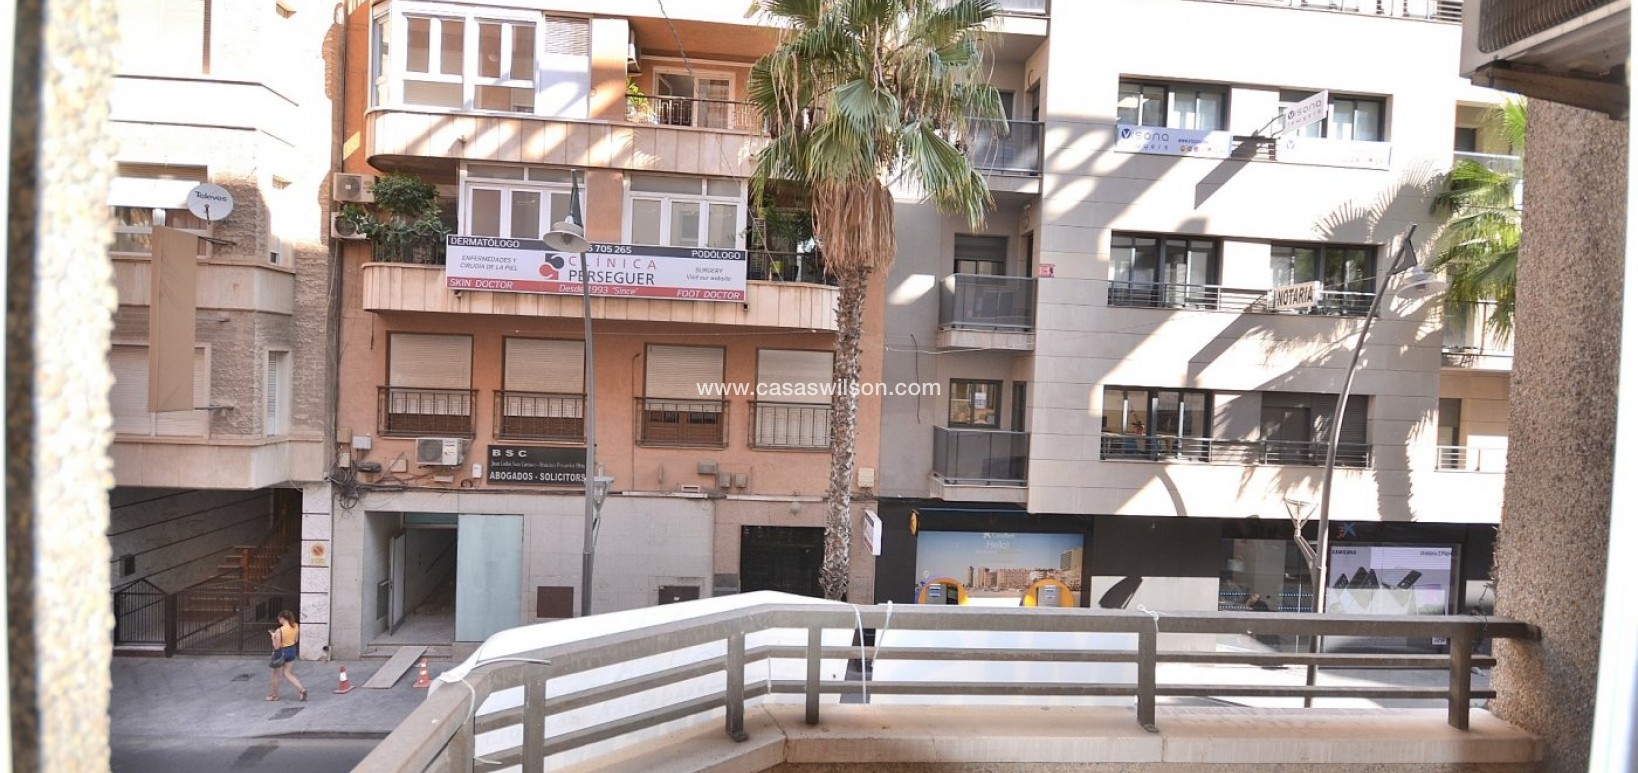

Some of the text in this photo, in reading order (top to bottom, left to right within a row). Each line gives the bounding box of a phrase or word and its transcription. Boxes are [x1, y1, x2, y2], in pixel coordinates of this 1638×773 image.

[595, 244, 613, 253] 705
[614, 245, 632, 254] 265
[568, 254, 657, 270] CÍNICA
[449, 278, 514, 290] SKIN DOCTOR
[676, 289, 741, 300] FOOT DOCTOR
[489, 471, 587, 482] ABOGADOS SOLICITORS
